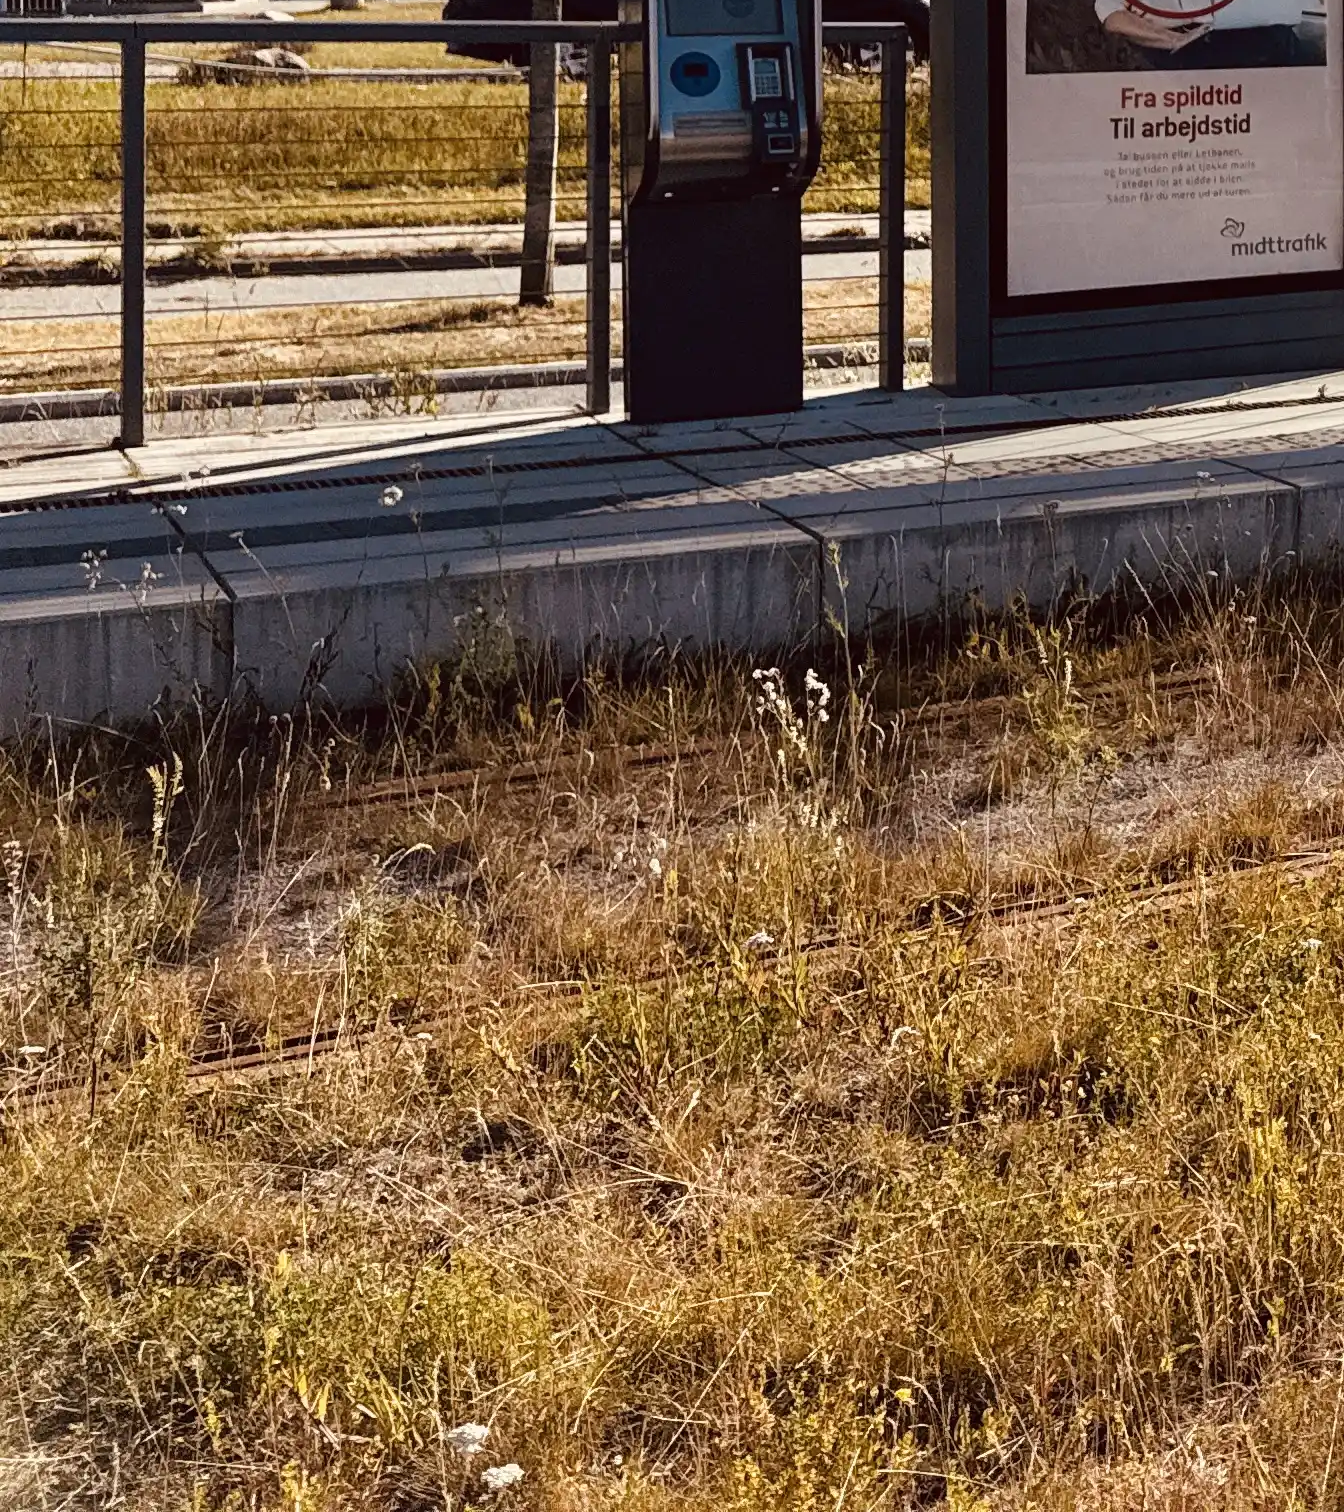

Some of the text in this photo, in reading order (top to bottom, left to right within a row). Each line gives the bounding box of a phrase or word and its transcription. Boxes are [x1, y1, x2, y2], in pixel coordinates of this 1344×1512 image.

[1121, 84, 1242, 114] Fra spildtid
[1109, 113, 1251, 143] Til arbejdstid
[1231, 233, 1327, 257] midttrafik
